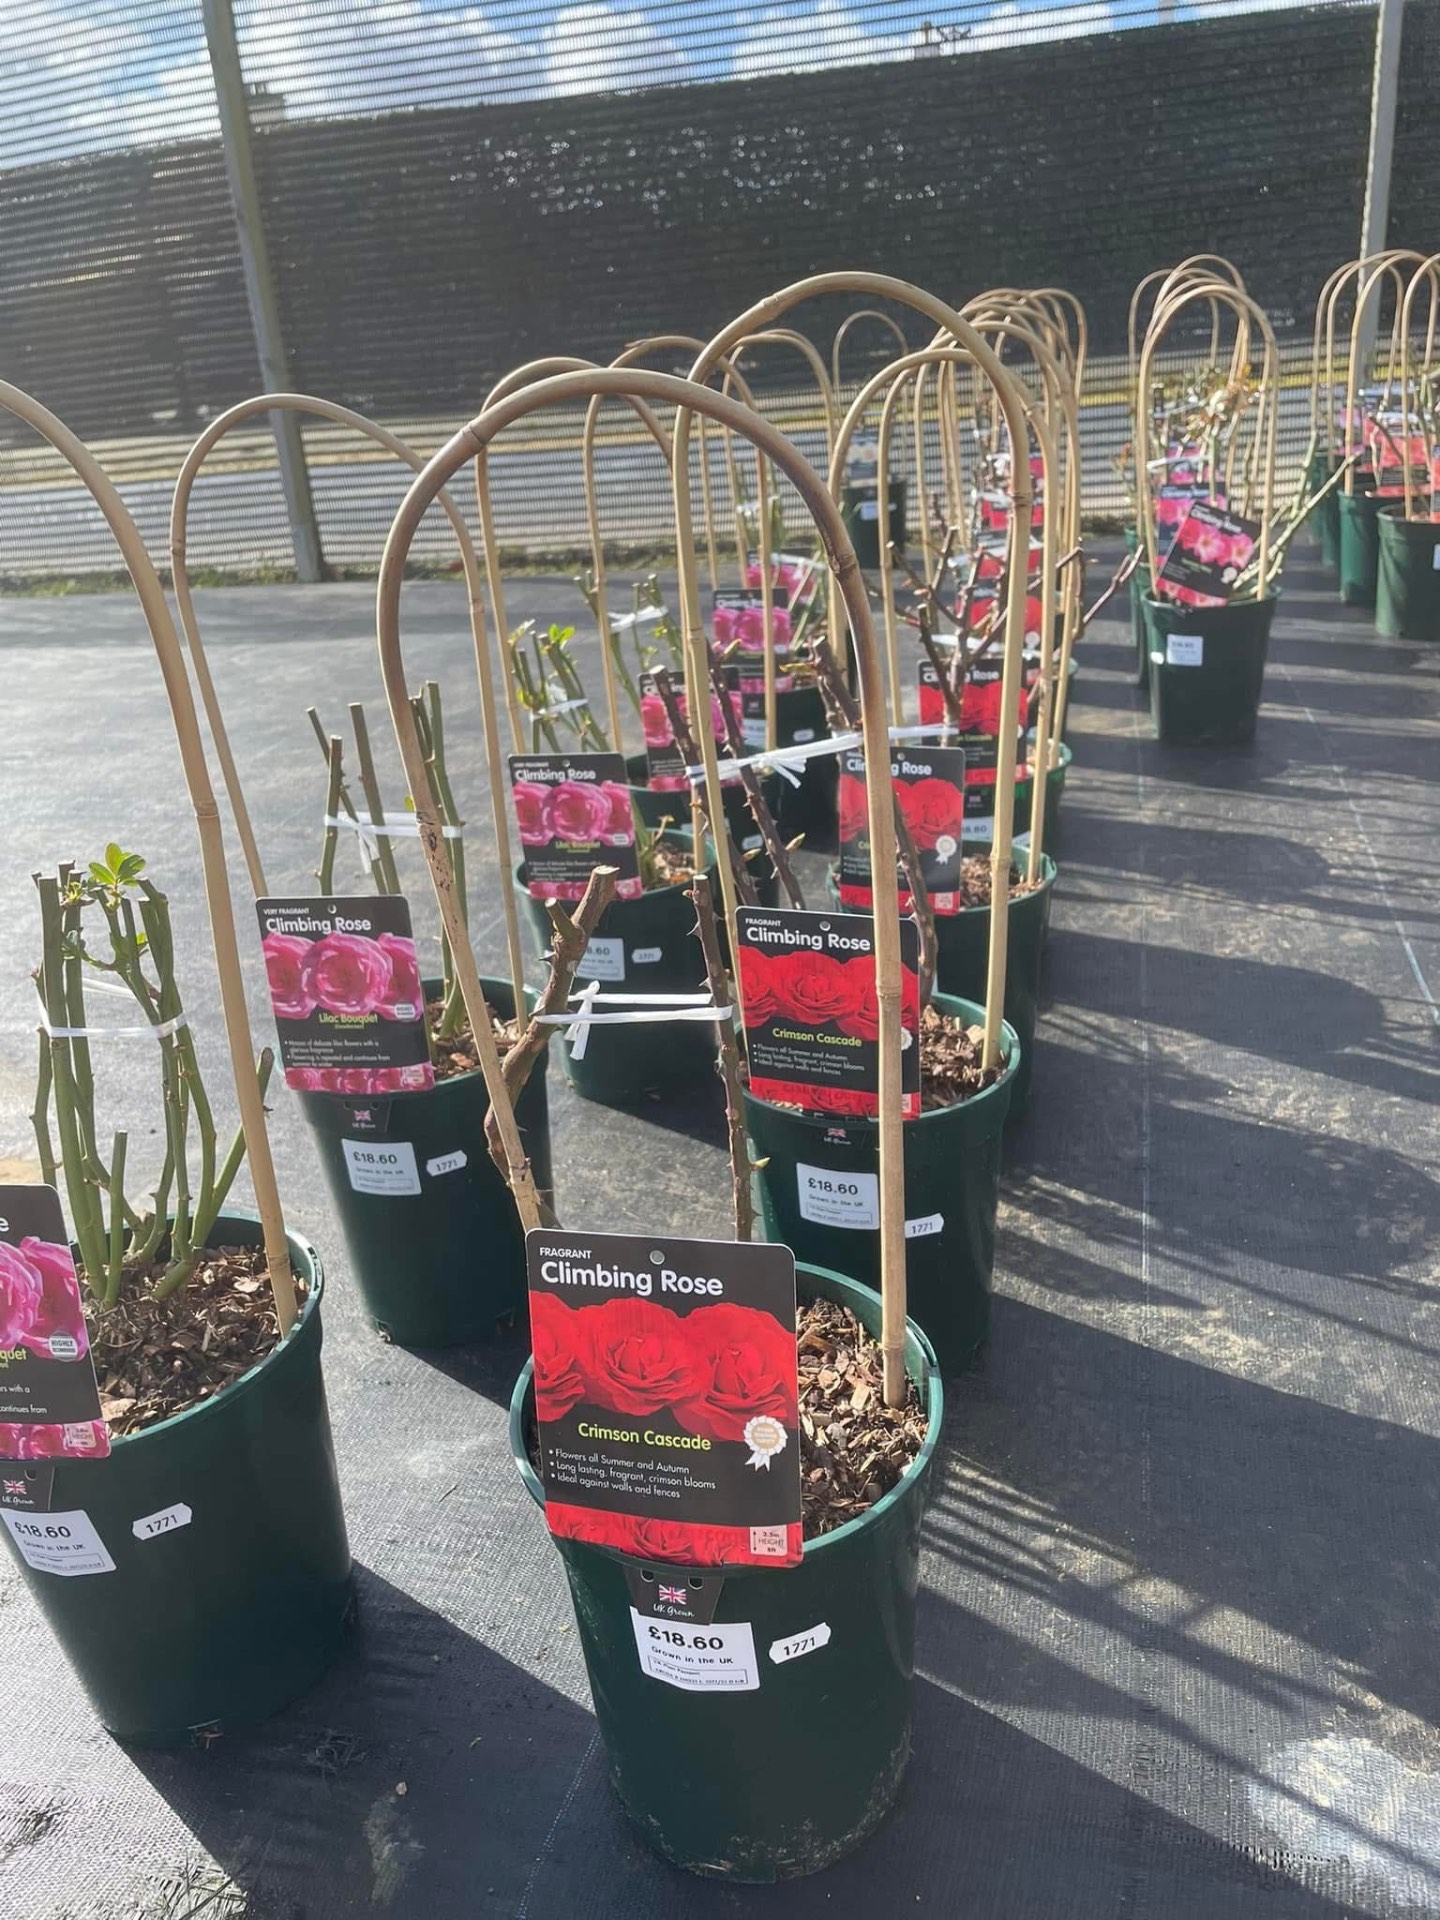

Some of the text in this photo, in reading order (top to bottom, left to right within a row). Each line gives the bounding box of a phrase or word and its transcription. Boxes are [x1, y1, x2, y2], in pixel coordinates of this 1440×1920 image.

[515, 768, 596, 782] Climbing Rose
[902, 761, 932, 775] Rose
[279, 907, 309, 915] FRAGRANT
[266, 917, 371, 934] Climbing Rose
[745, 918, 781, 926] FRAGRANT
[746, 927, 870, 951] Climbing Rose
[319, 1012, 378, 1025] Lilac Bouquet
[772, 1028, 862, 1047] Crimson Cascade
[353, 1151, 398, 1164] £18.60
[436, 1159, 457, 1172] 1771
[808, 1177, 858, 1196] £18.60
[911, 1222, 933, 1234] 1771
[540, 1247, 592, 1259] FRAGRANT
[541, 1260, 723, 1296] Climbing Rose
[0, 1348, 27, 1362] quet
[9, 1384, 24, 1393] with
[30, 1404, 48, 1414] from
[578, 1423, 712, 1450] Crimson Cascade
[556, 1449, 689, 1474] Flowers all Summer and Autumn
[556, 1461, 576, 1474] Long
[610, 1469, 646, 1483] fragrant,
[649, 1475, 681, 1486] crimson
[685, 1476, 716, 1489] blooms
[557, 1473, 680, 1498] Ideal against walls and fences
[14, 1521, 71, 1539] £18.60
[146, 1514, 178, 1533] 1771
[648, 1626, 724, 1650] £18.60
[651, 1646, 681, 1660] Grown
[783, 1637, 815, 1656] 1771
